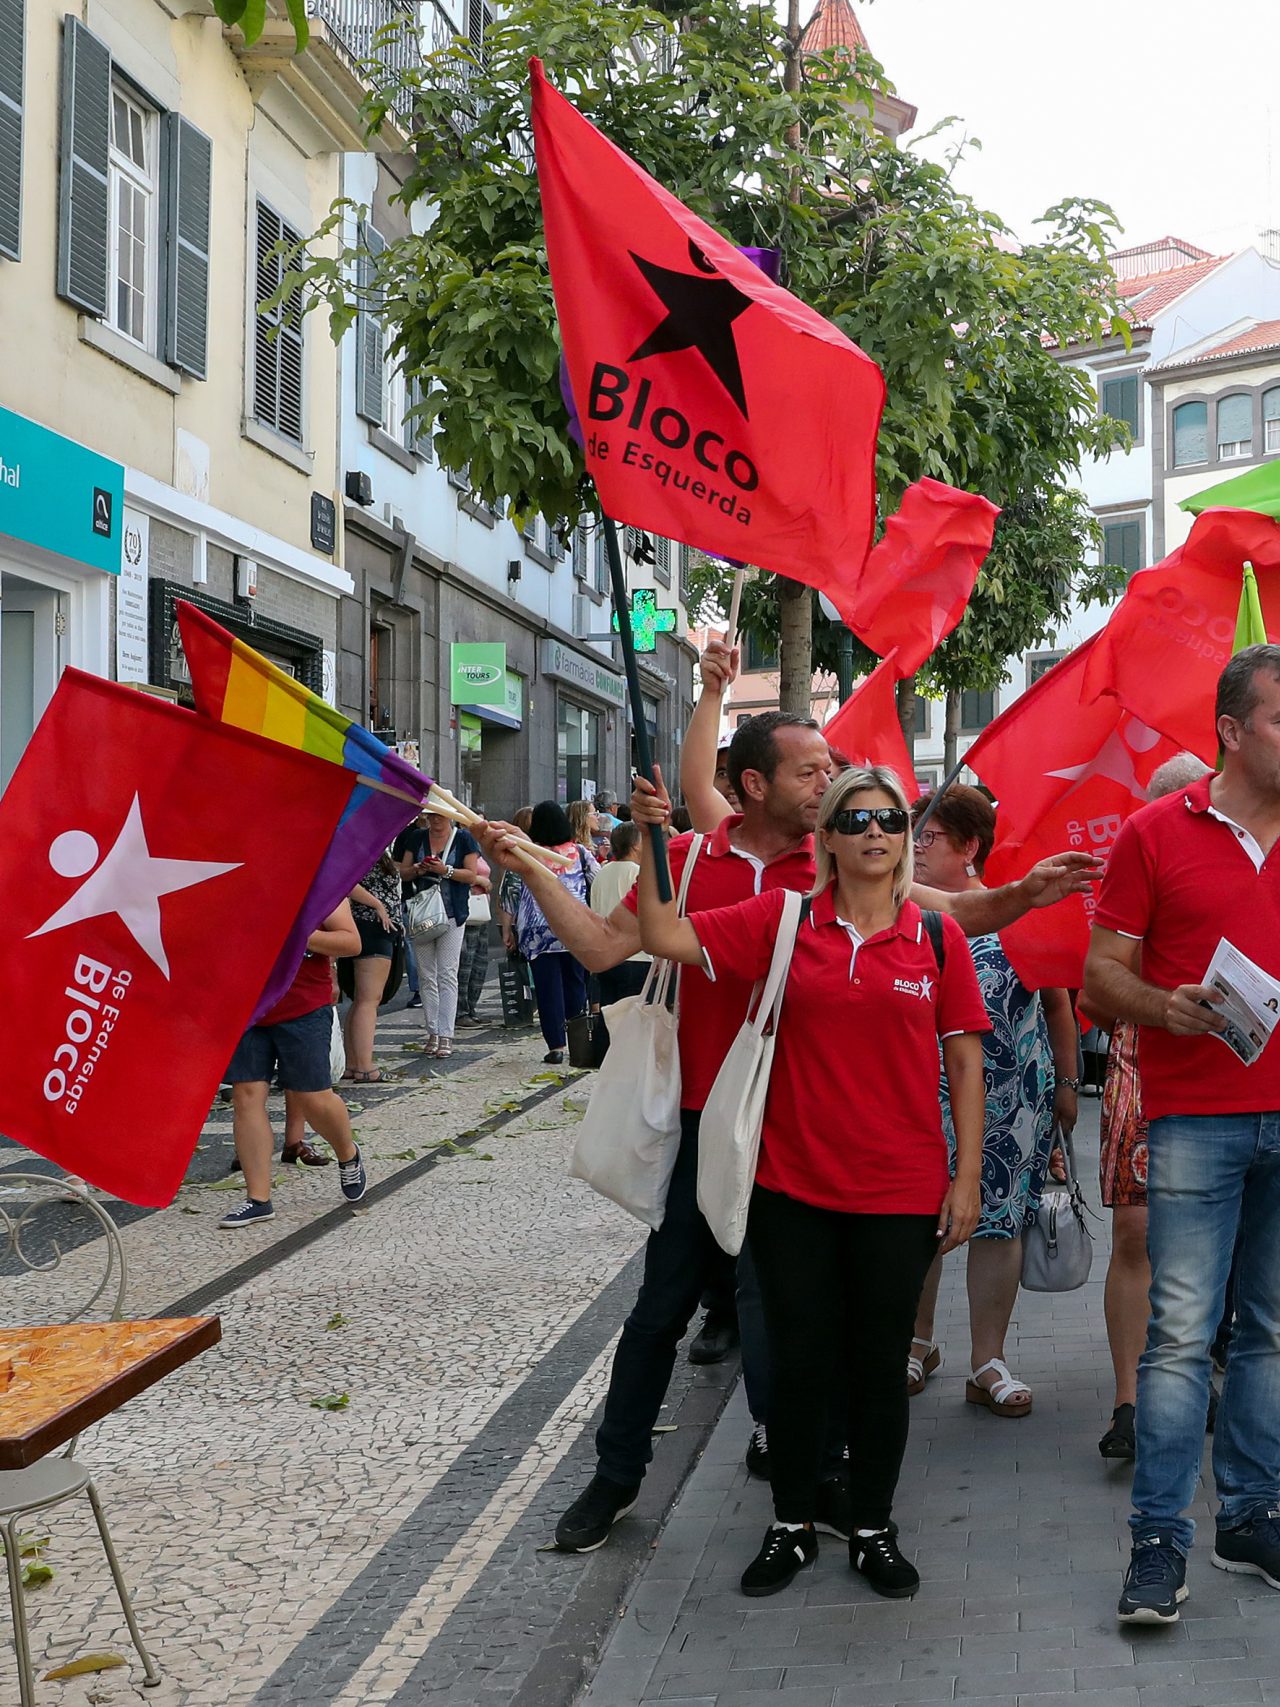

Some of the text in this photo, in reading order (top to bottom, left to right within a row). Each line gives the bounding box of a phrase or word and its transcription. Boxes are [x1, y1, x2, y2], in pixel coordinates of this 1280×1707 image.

[588, 361, 759, 492] Bloco
[621, 441, 752, 526] Esquerda
[129, 532, 138, 549] 70
[466, 672, 490, 680] TOURS
[561, 652, 595, 686] farmácia
[1066, 820, 1086, 846] de
[893, 978, 919, 991] BLOCO
